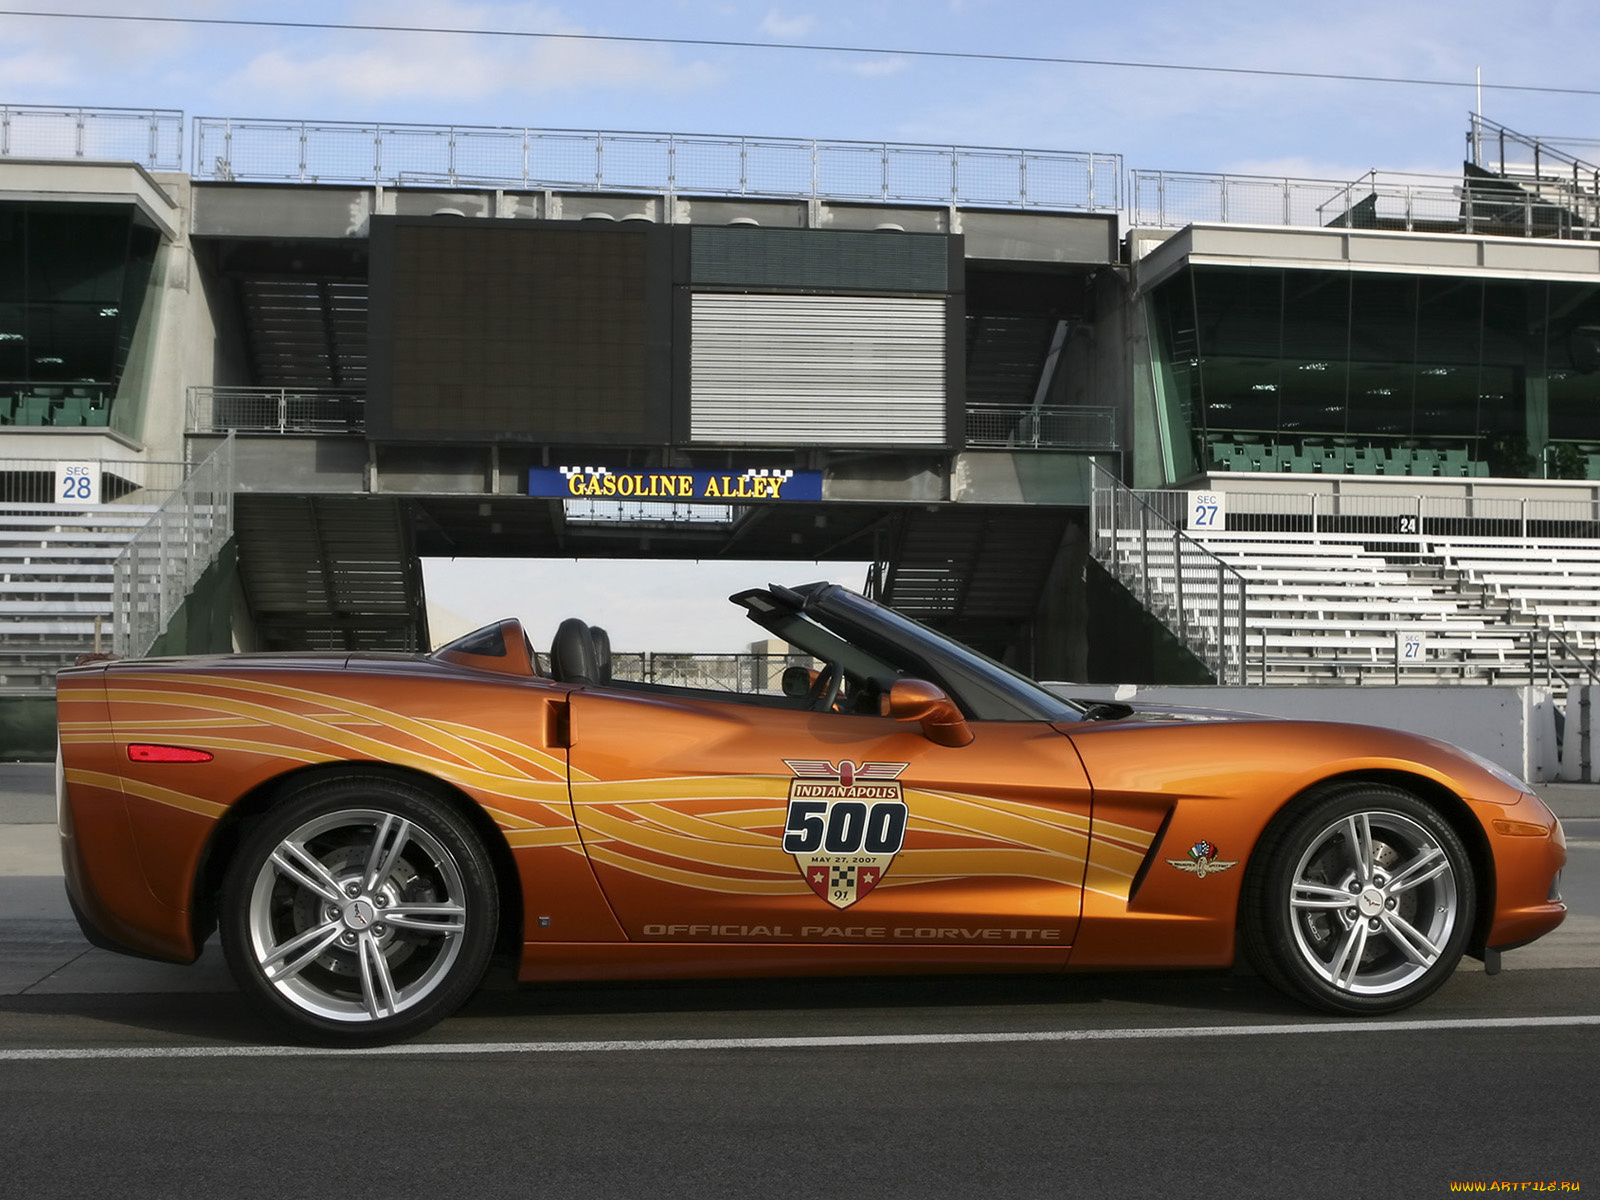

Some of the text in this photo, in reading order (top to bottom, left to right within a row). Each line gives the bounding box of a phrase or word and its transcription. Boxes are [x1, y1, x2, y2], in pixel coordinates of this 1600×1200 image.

[66, 466, 89, 476] SEC
[63, 476, 91, 499] 28
[568, 473, 785, 499] GASOLINE ALLEY
[1197, 495, 1217, 504] SEC
[1195, 505, 1218, 525] 27
[1400, 518, 1416, 533] 24
[1405, 642, 1420, 658] 27
[796, 786, 896, 798] INDIANAPOLIS
[783, 800, 909, 855] 500
[643, 924, 1061, 940] OFFICIAL PACE CORVETTE
